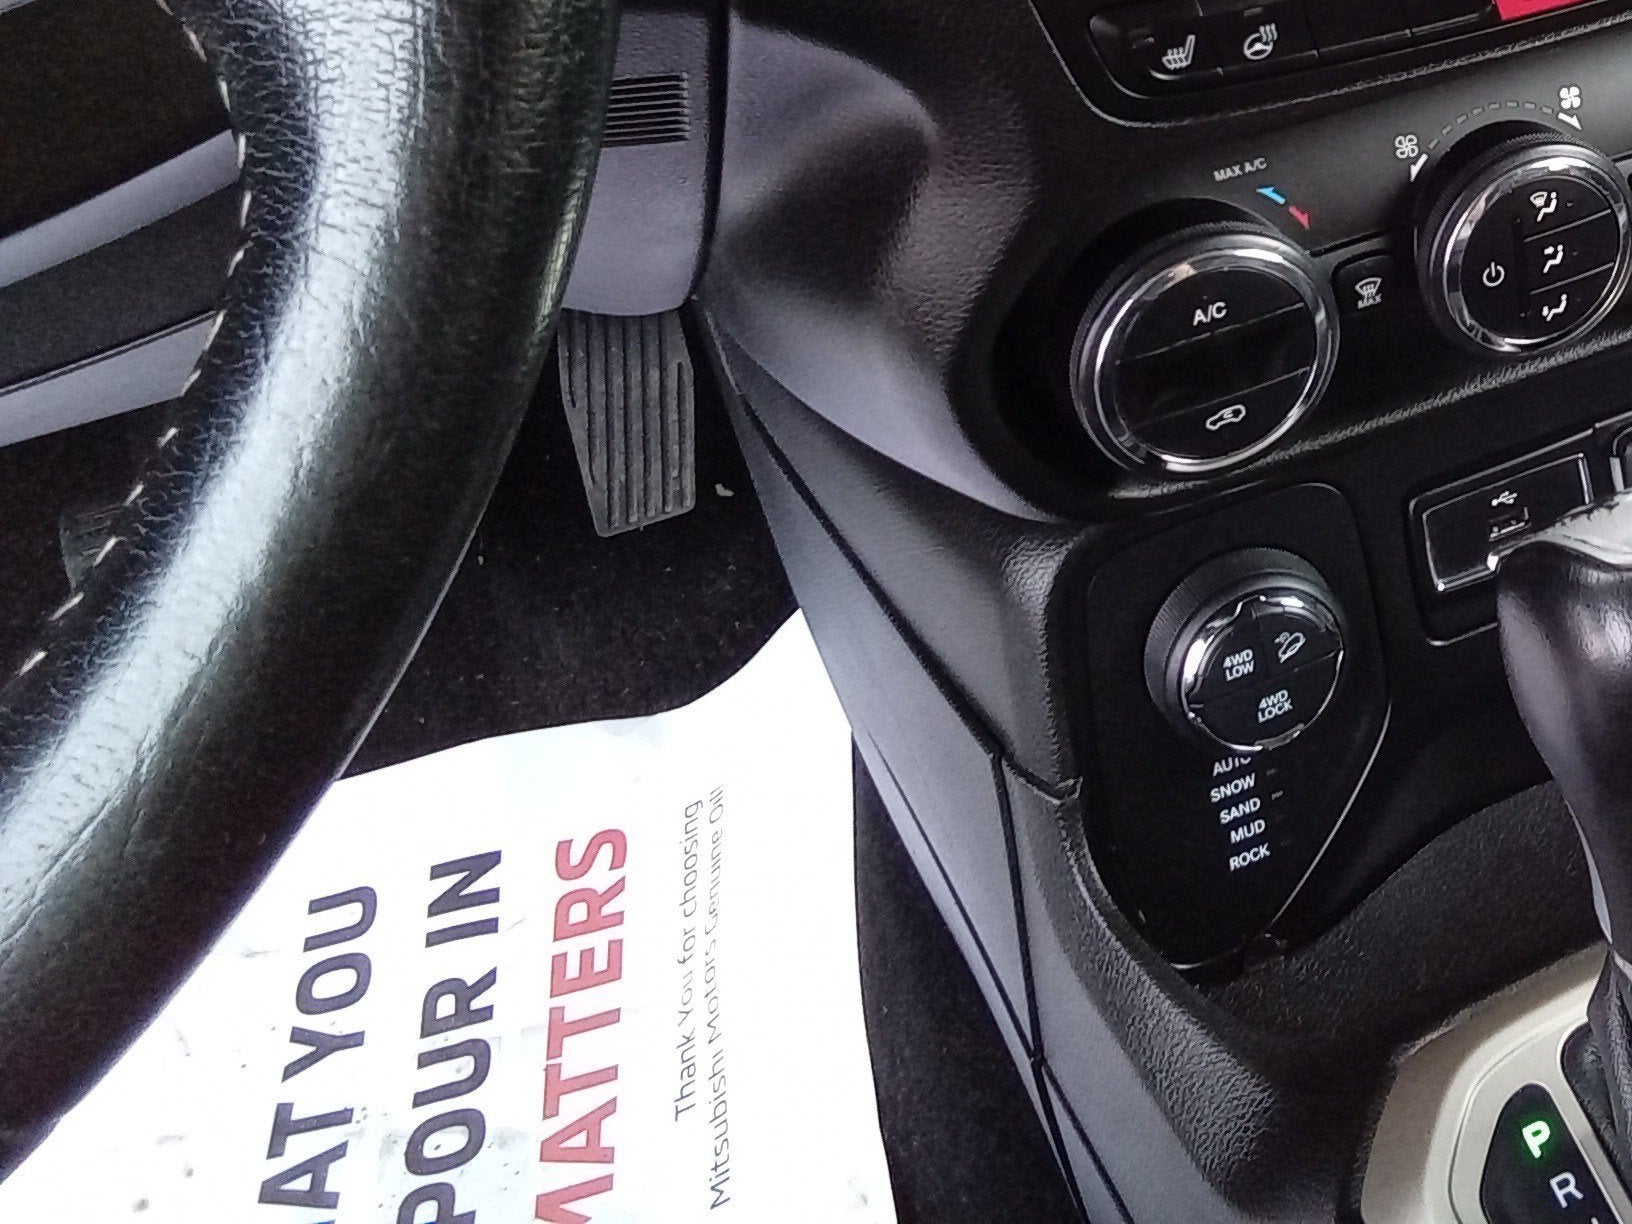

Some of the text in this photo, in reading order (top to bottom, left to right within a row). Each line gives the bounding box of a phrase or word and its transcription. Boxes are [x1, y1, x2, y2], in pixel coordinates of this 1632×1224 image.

[1214, 156, 1268, 182] MAX A/C
[1192, 300, 1228, 327] A/C
[1222, 648, 1254, 669] 4WD
[1226, 660, 1255, 681] LOW
[1257, 701, 1293, 723] LOCK
[1258, 688, 1289, 709] 4WD
[1210, 772, 1256, 803] SNOW
[1219, 797, 1261, 825] SAND
[1229, 819, 1266, 844] MUD
[1229, 842, 1271, 872] ROCK
[425, 849, 502, 949] IN
[674, 799, 703, 1123] Thank You for choosing
[704, 938, 723, 1045] Motors
[257, 885, 378, 1224] AT YOU
[708, 1048, 732, 1211] Mitsubishi
[1521, 1120, 1551, 1159] P
[1550, 1172, 1584, 1208] R
